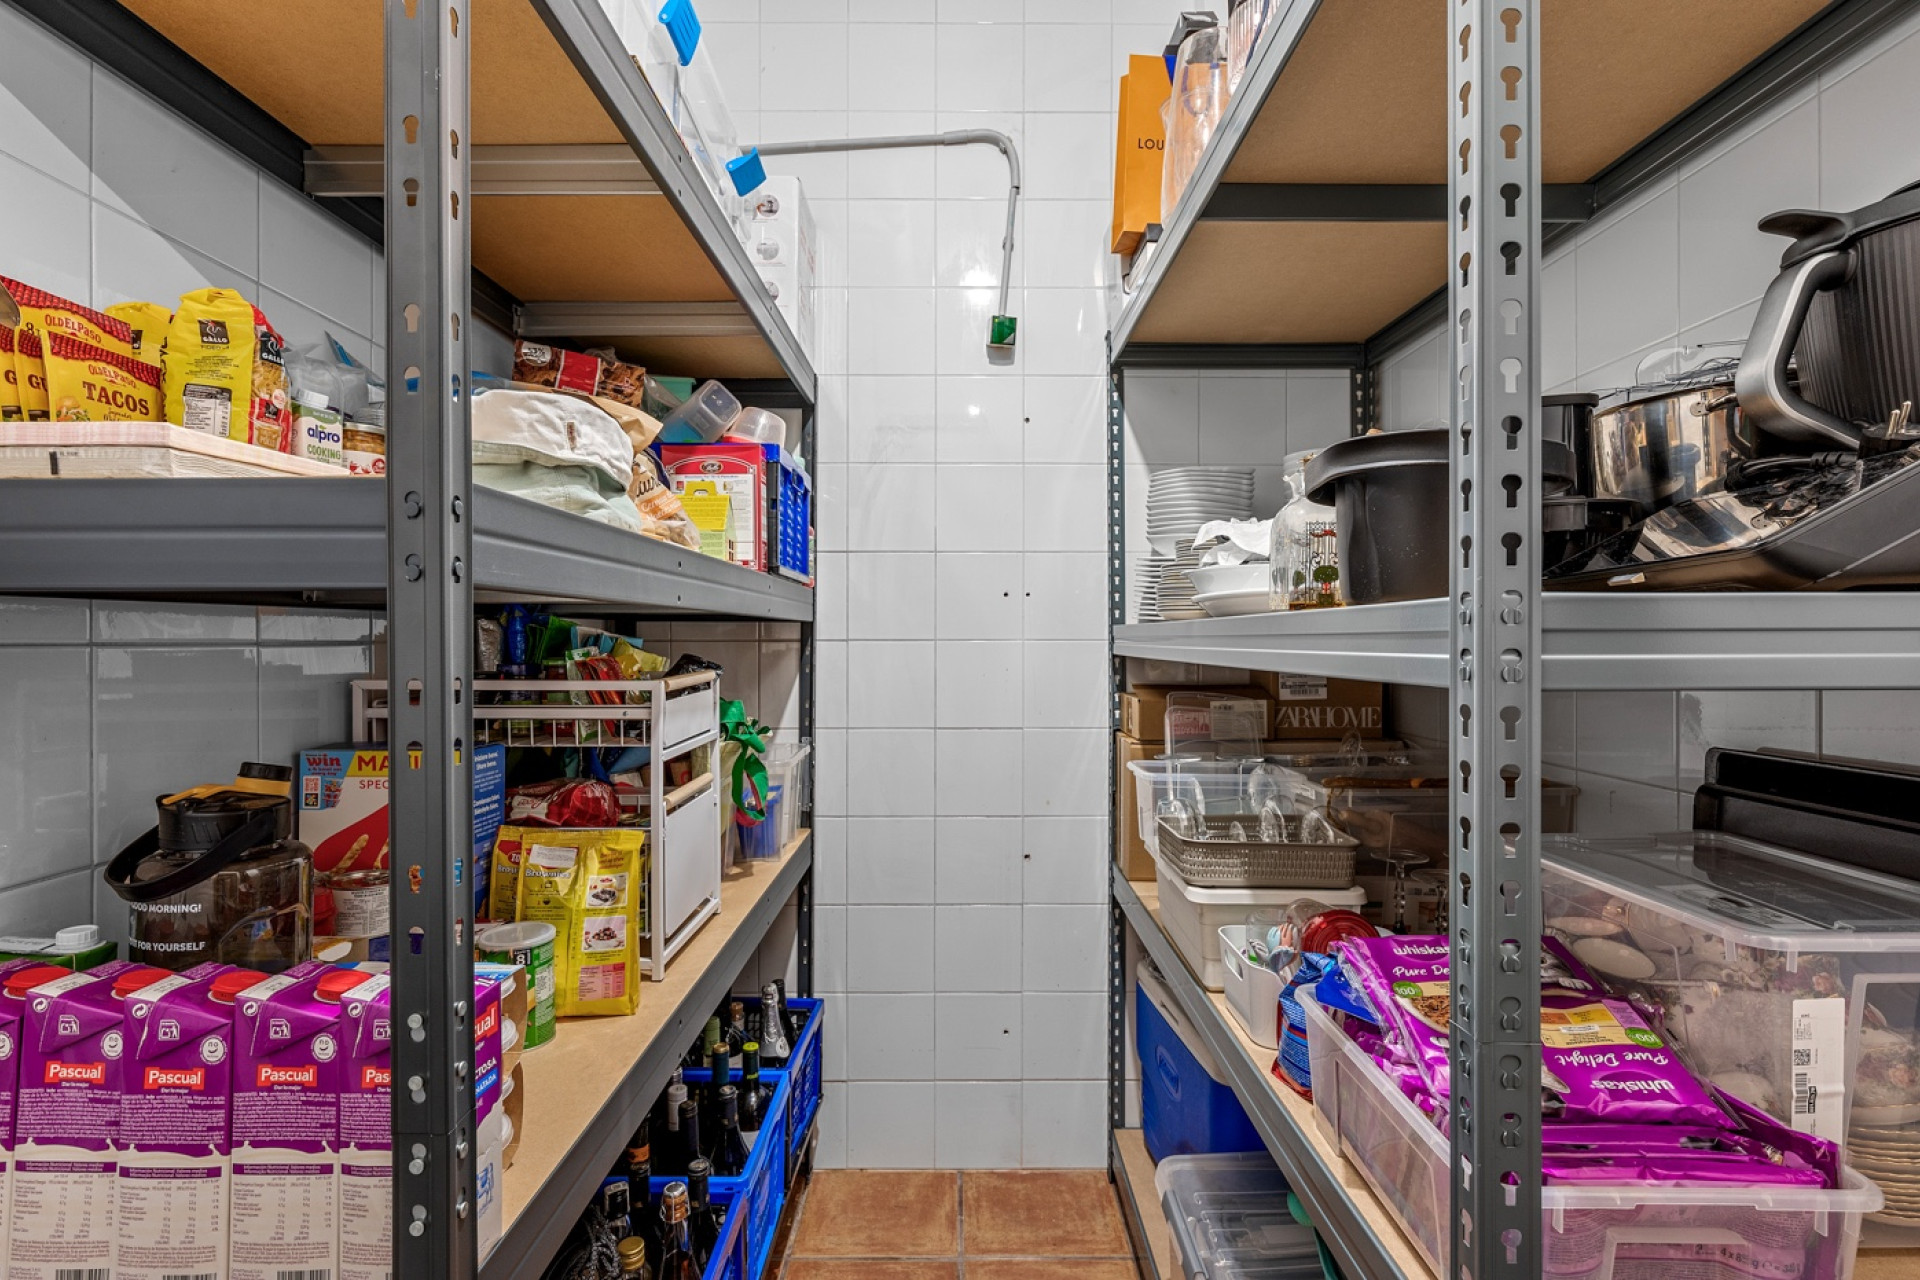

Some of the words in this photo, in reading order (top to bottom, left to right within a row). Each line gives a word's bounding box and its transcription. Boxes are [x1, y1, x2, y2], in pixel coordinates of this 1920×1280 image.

[1138, 138, 1164, 151] LOU
[82, 381, 150, 416] TACOS
[307, 424, 340, 444] alpro
[306, 443, 340, 460] COOKING
[305, 753, 342, 767] win
[148, 903, 202, 914] MORNING!
[152, 941, 206, 952] YOURSELF
[1392, 965, 1428, 979] Pure
[1554, 1049, 1620, 1067] Delight
[1622, 1051, 1668, 1066] Pure
[49, 1063, 102, 1079] Pascual
[148, 1070, 201, 1085] Pascual
[261, 1067, 314, 1082] Pascual
[1591, 1079, 1675, 1094] whiskas
